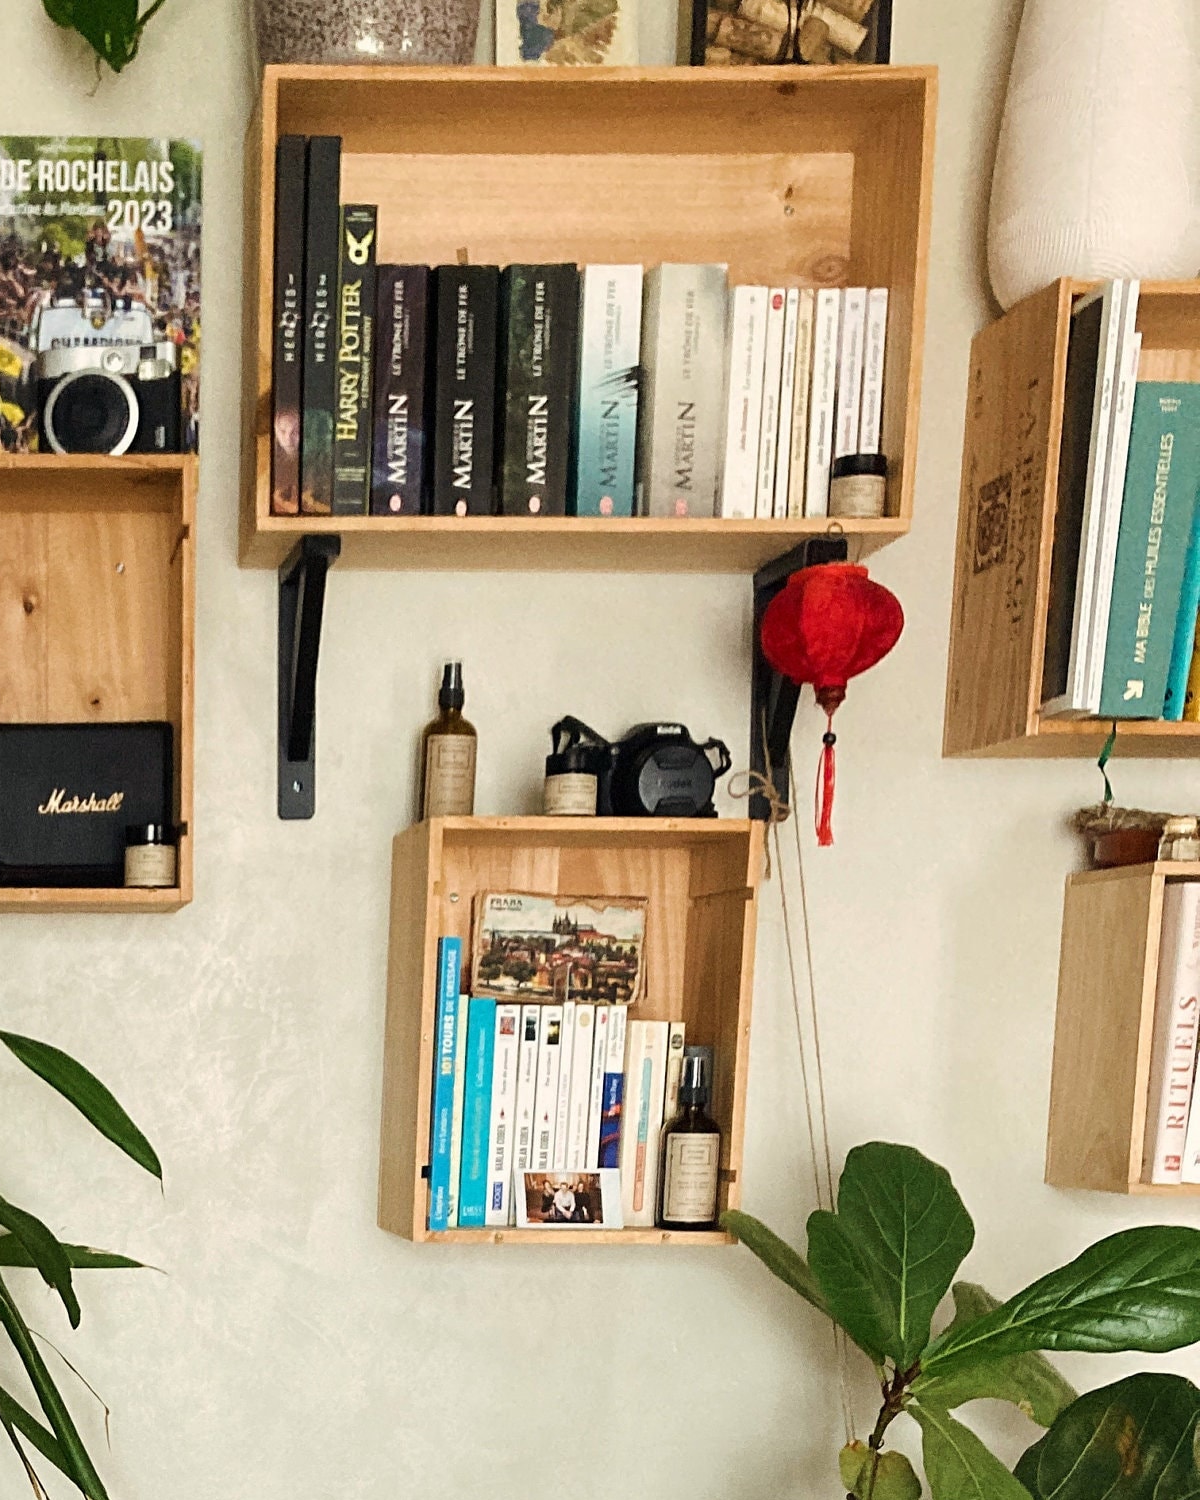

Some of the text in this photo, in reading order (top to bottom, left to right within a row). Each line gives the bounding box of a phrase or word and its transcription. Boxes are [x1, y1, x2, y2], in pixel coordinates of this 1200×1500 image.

[38, 160, 175, 193] ROCHELAIS
[107, 200, 174, 232] 2023
[336, 280, 361, 441] HARRY POTTER
[388, 393, 409, 484] MARTIN
[452, 399, 474, 489] MARTIN
[527, 394, 548, 484] MARTIN
[599, 400, 620, 488] MARTIN
[673, 402, 696, 490] MARTIN
[1150, 433, 1174, 525] ESSENTIELLES
[1145, 527, 1162, 575] HUILES
[1134, 640, 1148, 664] MA
[1136, 604, 1153, 638] BIBLE
[38, 789, 125, 815] Marshall
[441, 949, 457, 1076] 101 TOURS DE DRESSAGE
[1165, 995, 1198, 1130] RITUELS
[495, 1124, 506, 1171] HARLAN COBEN
[520, 1126, 529, 1145] COBEN
[540, 1130, 549, 1149] COBEN
